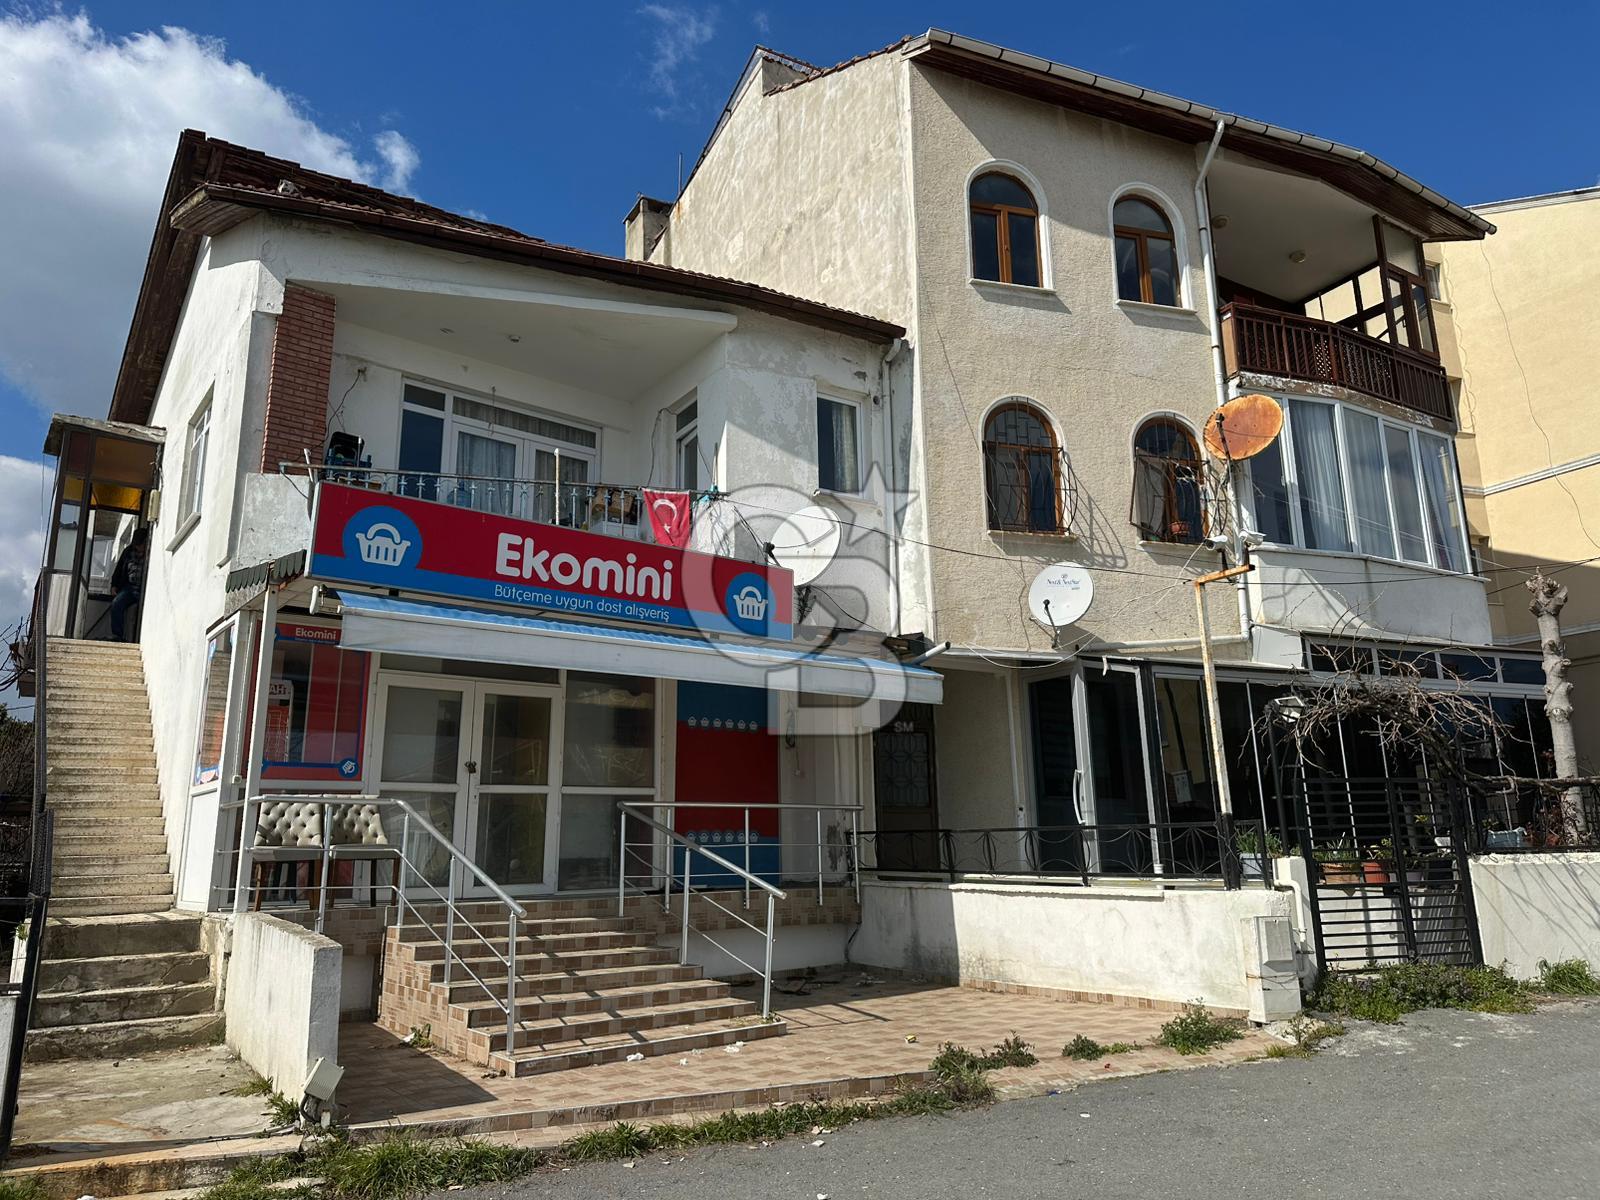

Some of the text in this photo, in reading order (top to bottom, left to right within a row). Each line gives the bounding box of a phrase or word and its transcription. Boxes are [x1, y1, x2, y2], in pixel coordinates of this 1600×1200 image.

[495, 532, 673, 601] Ekomini
[494, 584, 670, 621] Bütçeme uygun dost alışveriş
[295, 627, 337, 640] Ekomini
